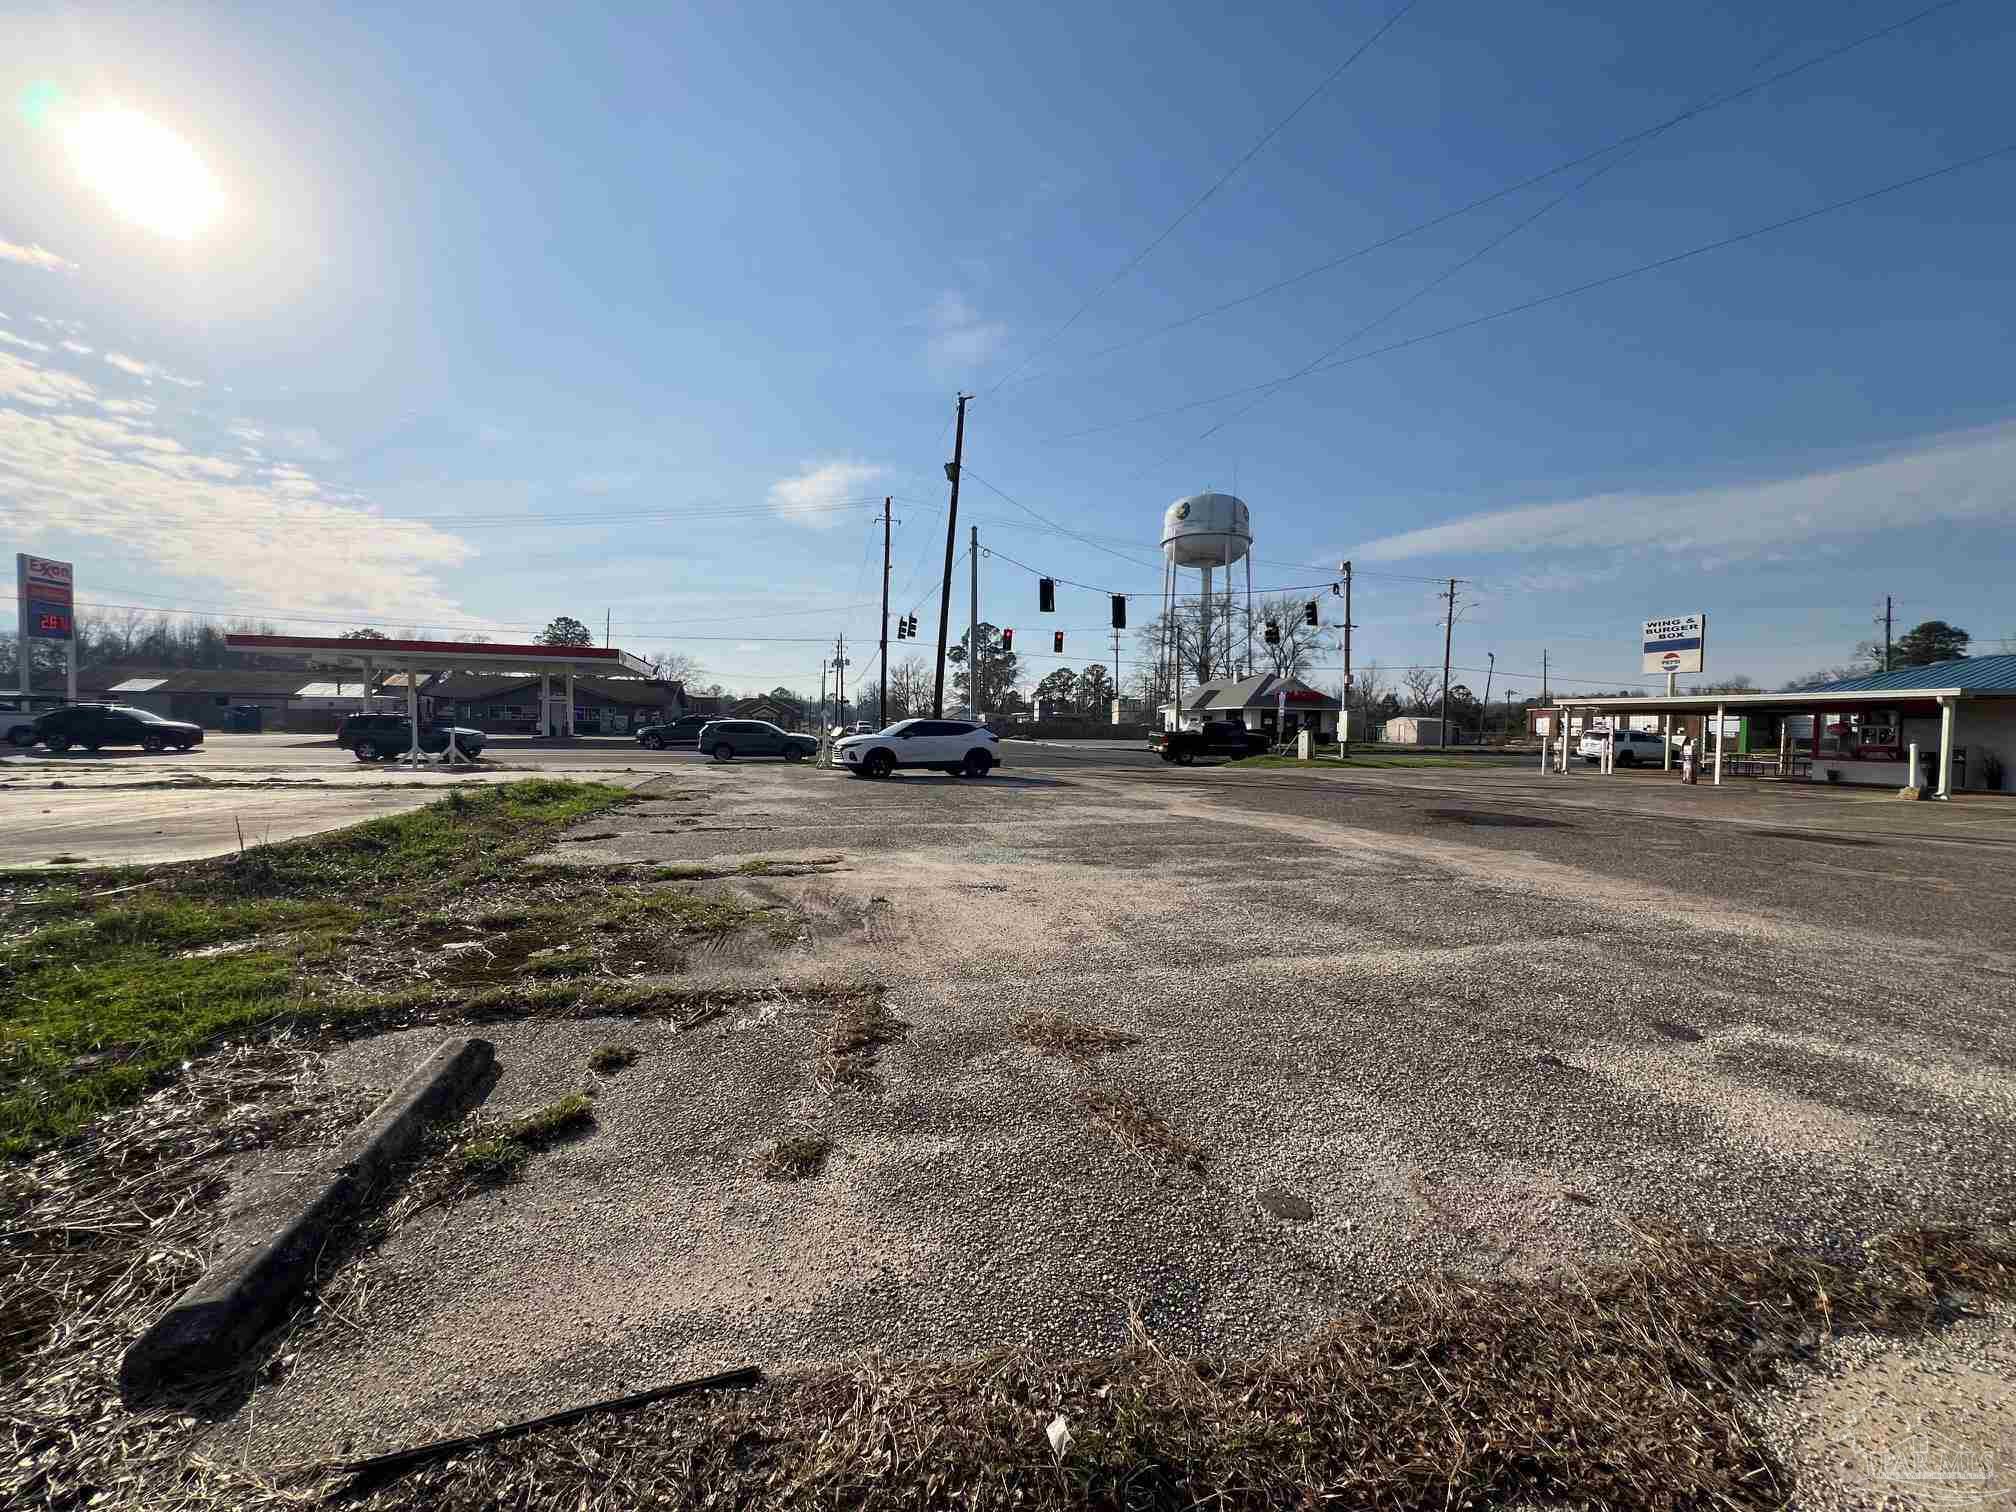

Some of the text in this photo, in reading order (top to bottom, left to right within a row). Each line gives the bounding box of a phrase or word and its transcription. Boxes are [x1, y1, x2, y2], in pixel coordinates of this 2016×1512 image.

[31, 560, 69, 577] Exxon
[1646, 624, 1699, 635] BURGER
[1647, 620, 1681, 628] WING
